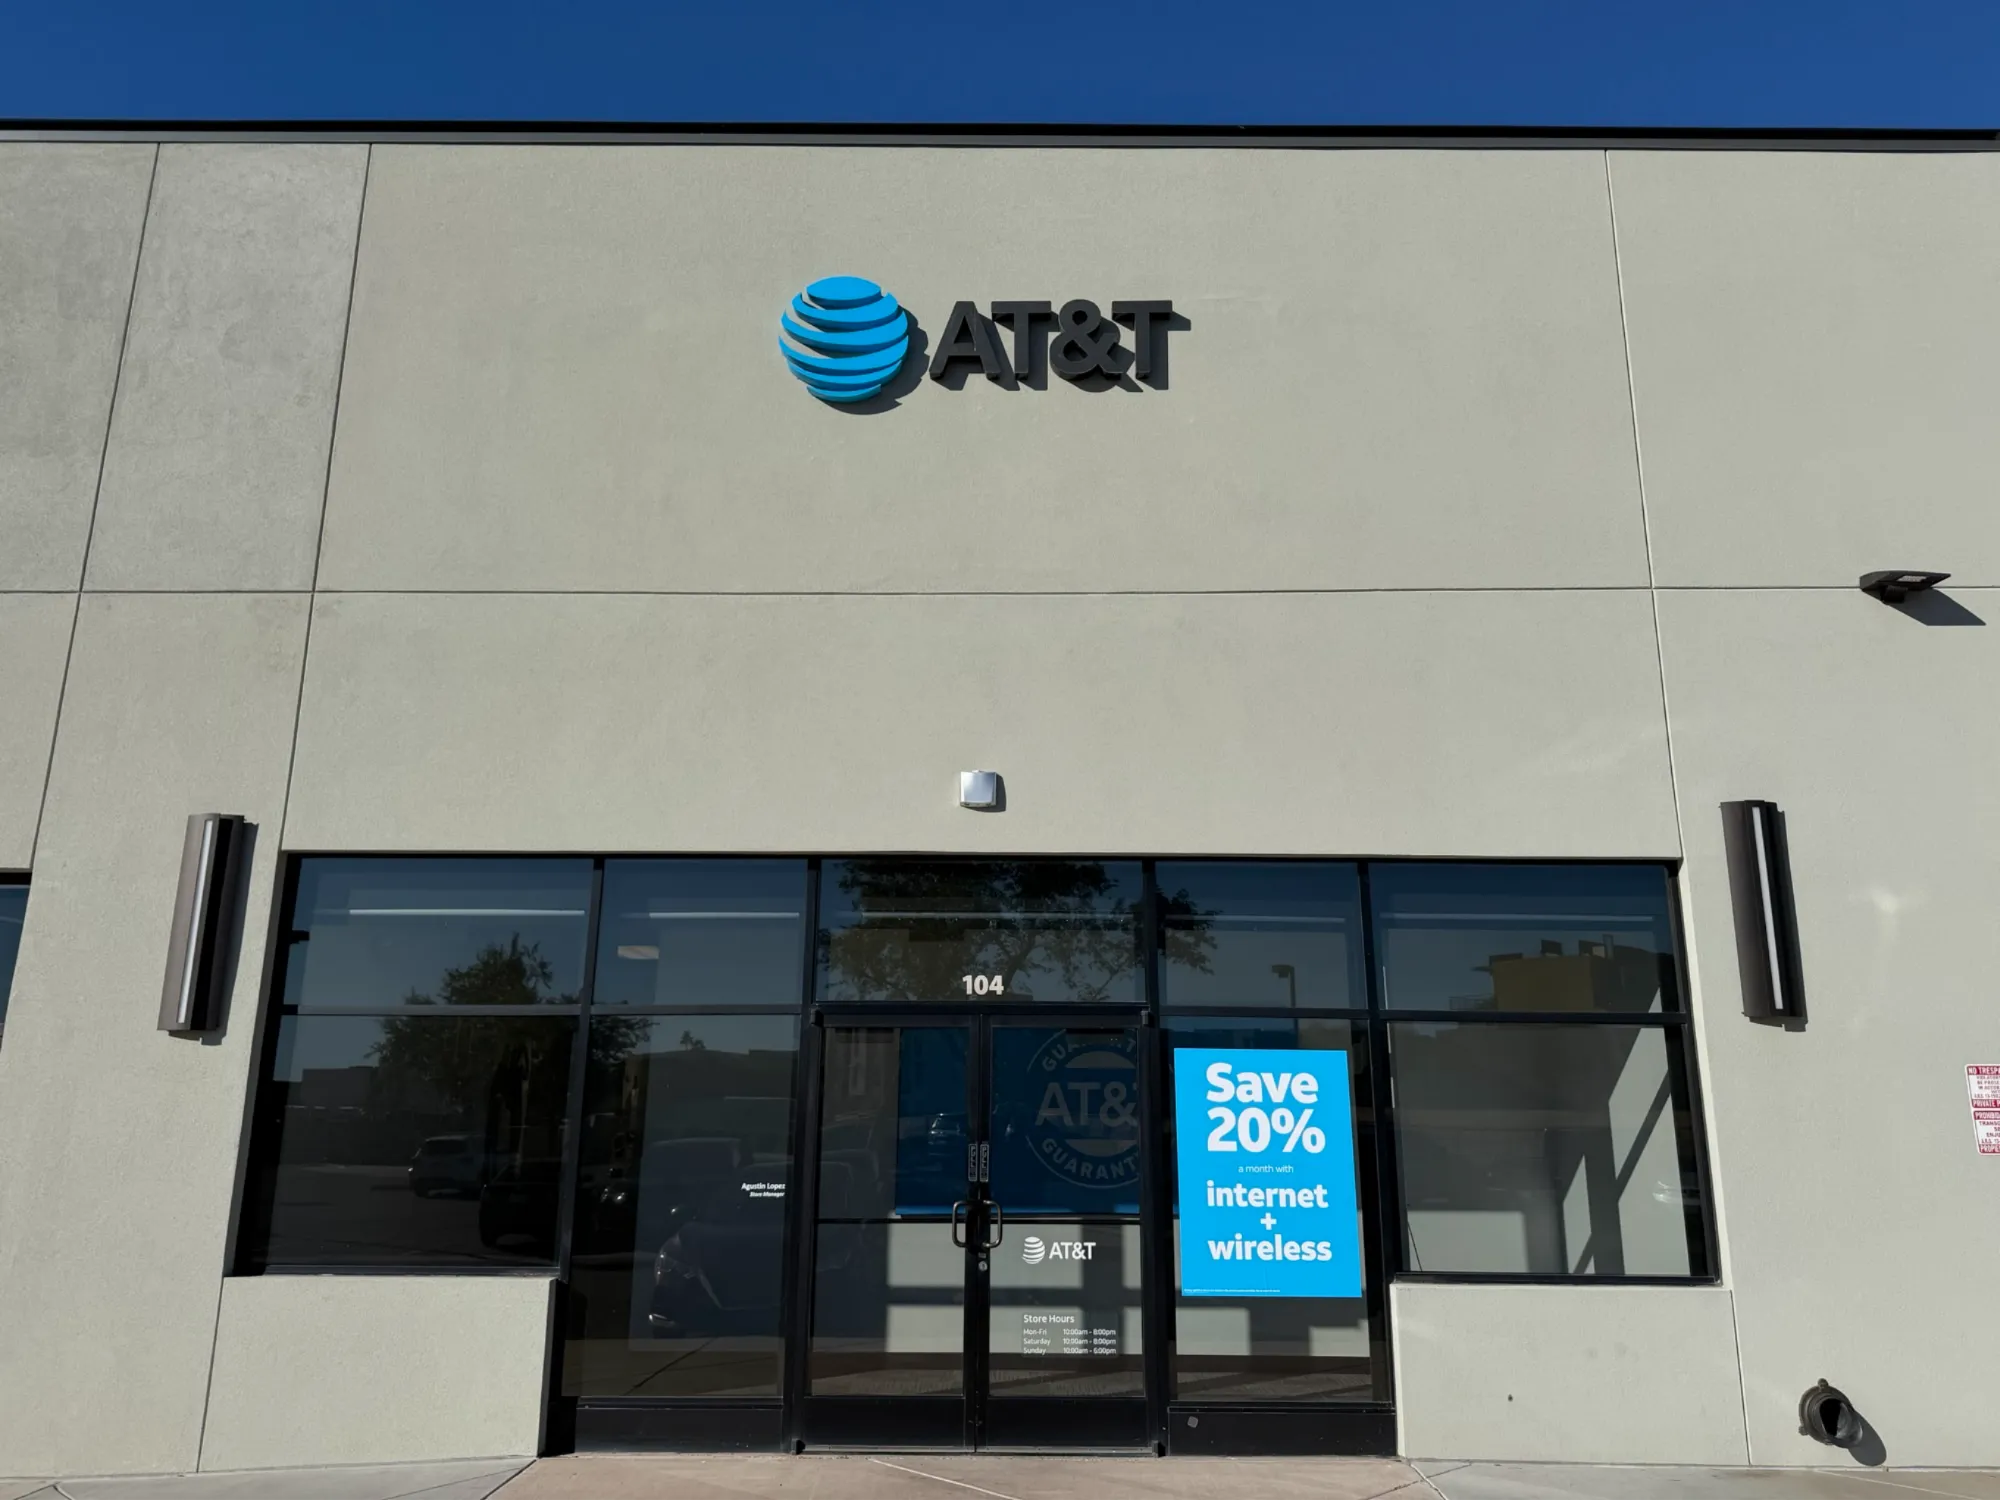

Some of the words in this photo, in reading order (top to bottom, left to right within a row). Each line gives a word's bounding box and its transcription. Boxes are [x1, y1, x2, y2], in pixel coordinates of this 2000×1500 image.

[929, 299, 1173, 381] AT&T
[962, 974, 1004, 995] 104
[1968, 1067, 1977, 1075] NO
[1206, 1062, 1319, 1104] Save
[1035, 1081, 1138, 1127] AT&
[1973, 1099, 1996, 1107] PRIVATE
[1207, 1107, 1326, 1154] 20%
[1041, 1138, 1138, 1179] GUARANT
[1245, 1164, 1274, 1173] month
[1275, 1164, 1294, 1173] with
[1207, 1180, 1329, 1208] internet
[1260, 1213, 1277, 1230] +
[1048, 1241, 1097, 1260] AT&T
[1207, 1233, 1333, 1261] wireless
[1023, 1314, 1047, 1323] Store
[1048, 1314, 1075, 1323] Hours
[1093, 1328, 1116, 1336] 8:00pm
[1023, 1338, 1051, 1346] Saturday
[1093, 1338, 1116, 1346] 8:00pm
[1023, 1347, 1046, 1355] Sunday
[1093, 1347, 1116, 1355] 6:00pm
